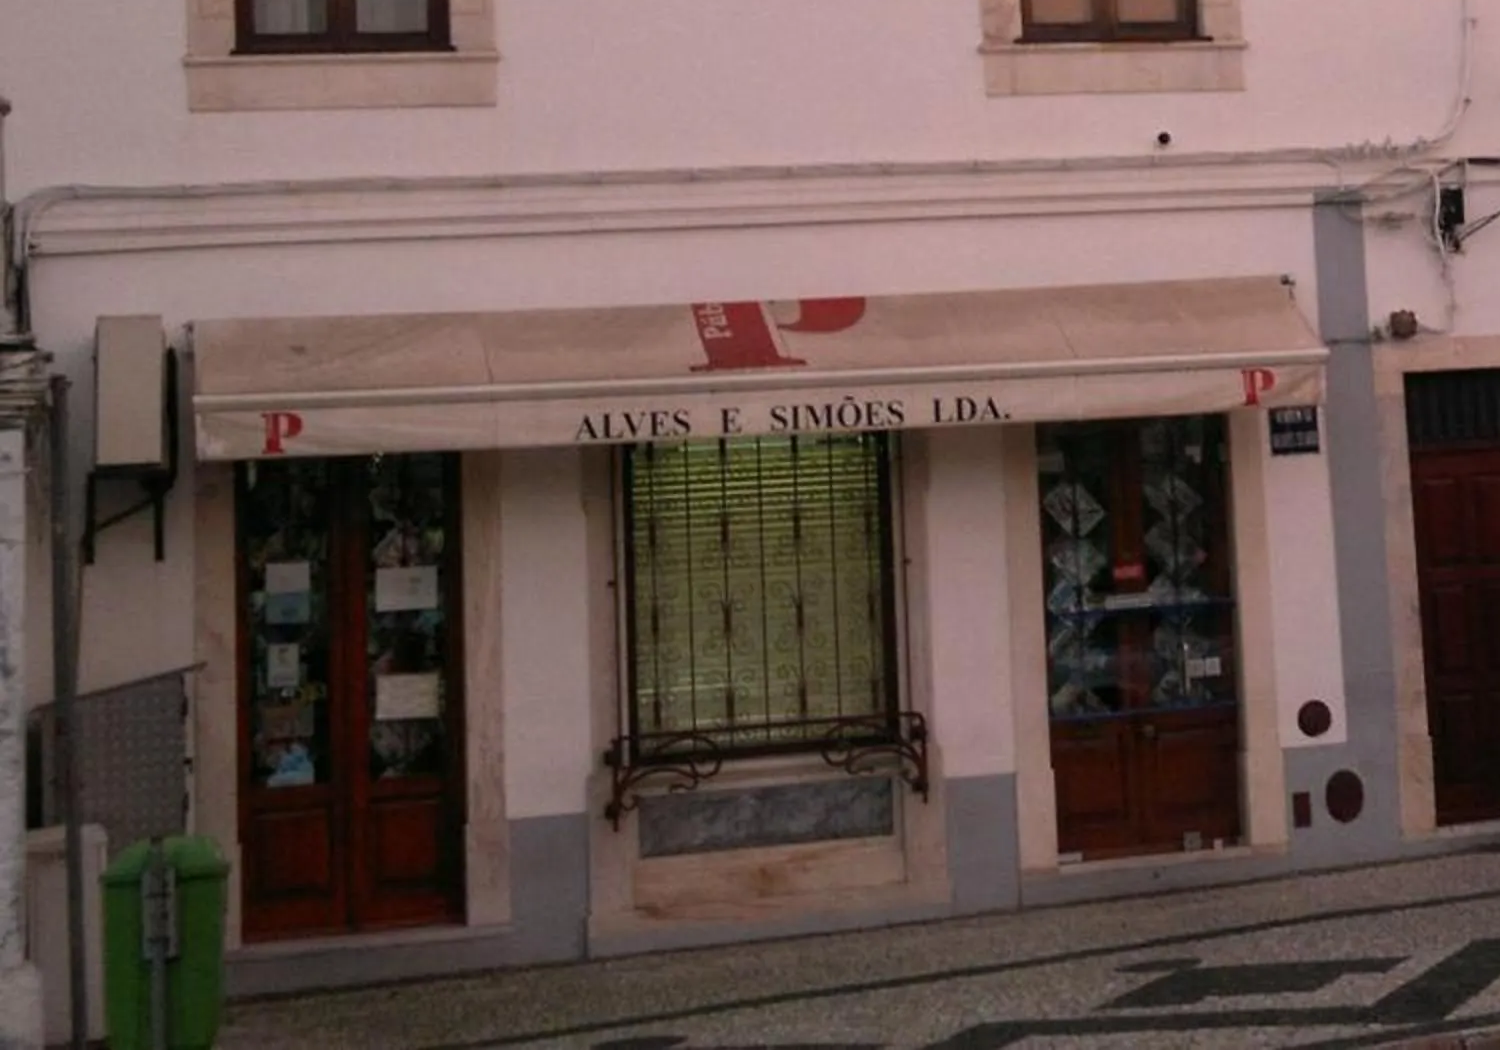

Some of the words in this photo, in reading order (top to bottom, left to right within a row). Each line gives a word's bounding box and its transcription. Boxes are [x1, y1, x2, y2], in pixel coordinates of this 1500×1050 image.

[261, 411, 304, 454] P
[575, 409, 692, 440] ALVES
[721, 408, 743, 434] E
[770, 395, 904, 432] SIMÕES
[933, 397, 1012, 423] LDA.
